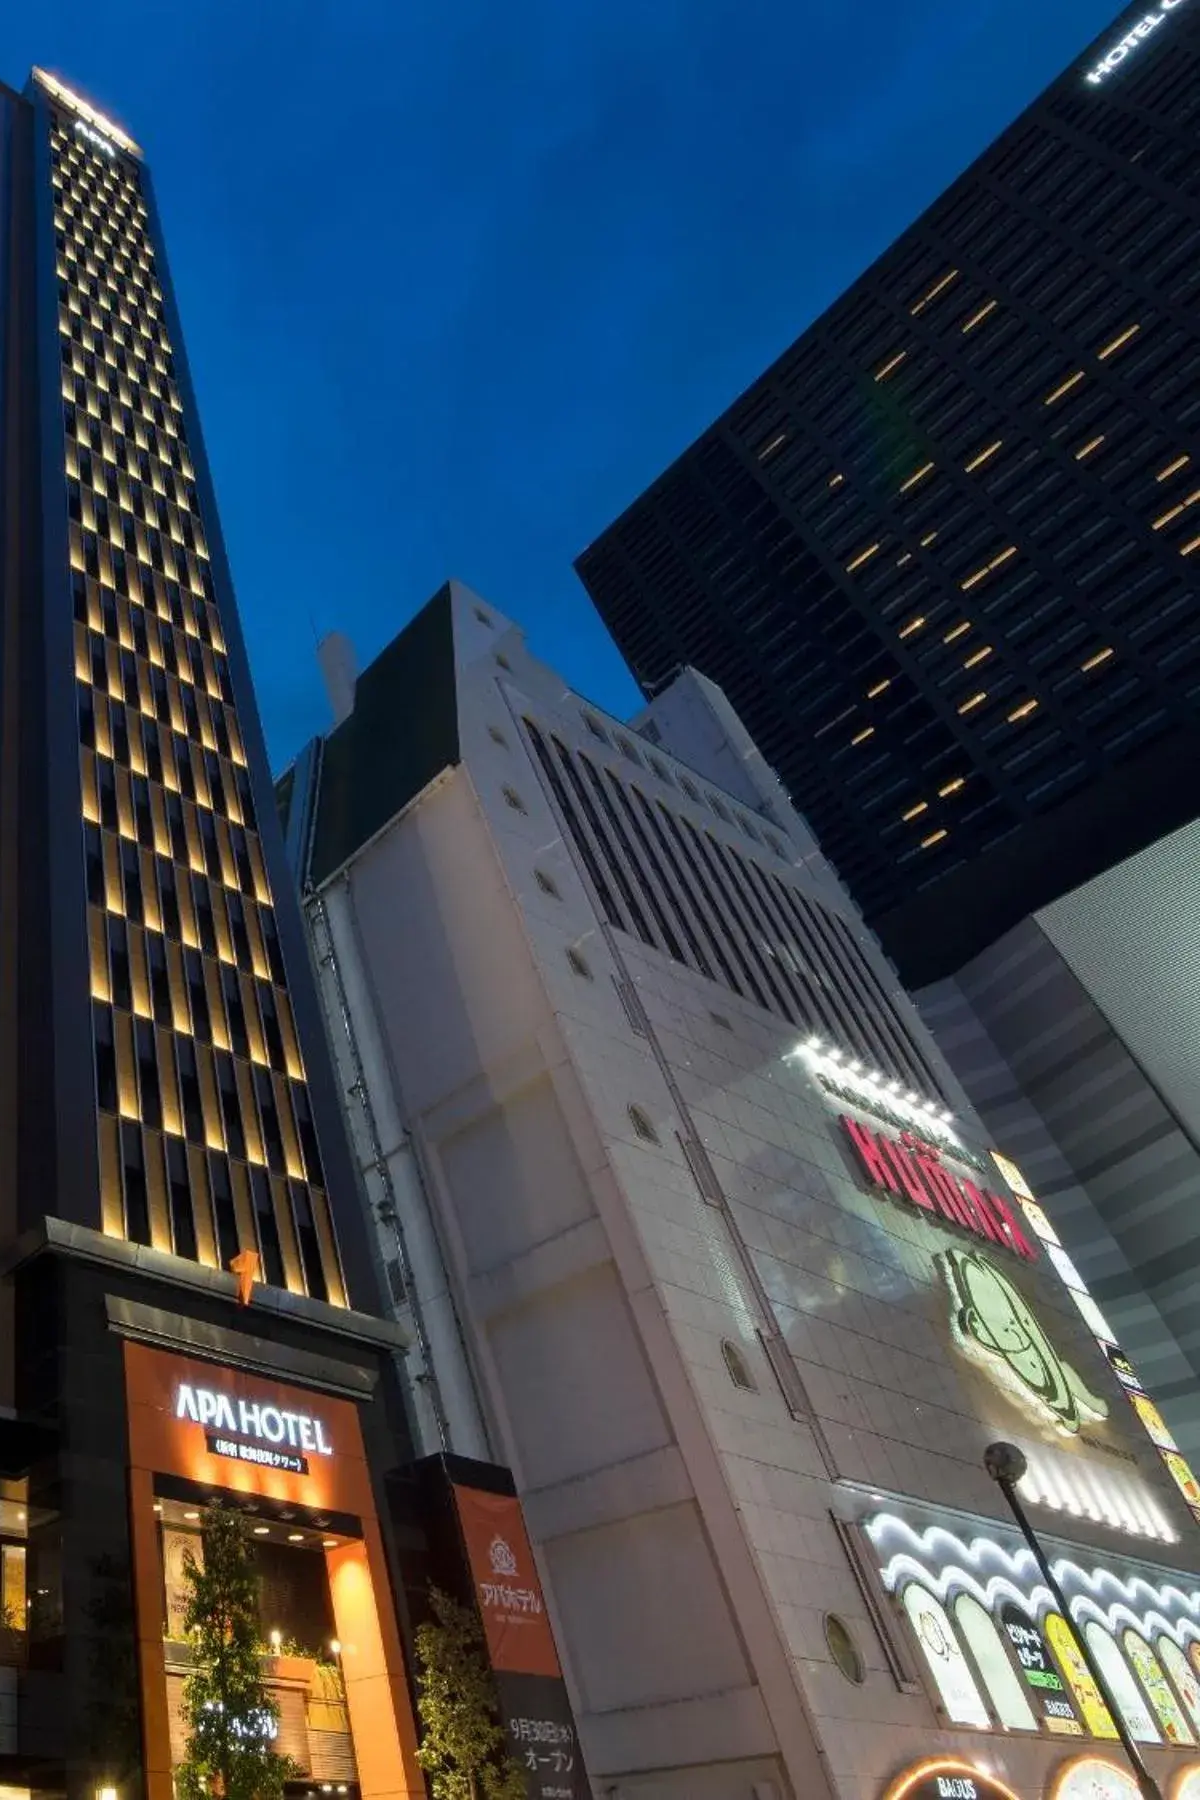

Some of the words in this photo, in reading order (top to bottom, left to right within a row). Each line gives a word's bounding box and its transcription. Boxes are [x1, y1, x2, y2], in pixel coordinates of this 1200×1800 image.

[1086, 13, 1165, 83] HOTEL
[176, 1383, 237, 1431] APA
[238, 1400, 333, 1455] HOTEL
[937, 1776, 977, 1799] BAGUS
